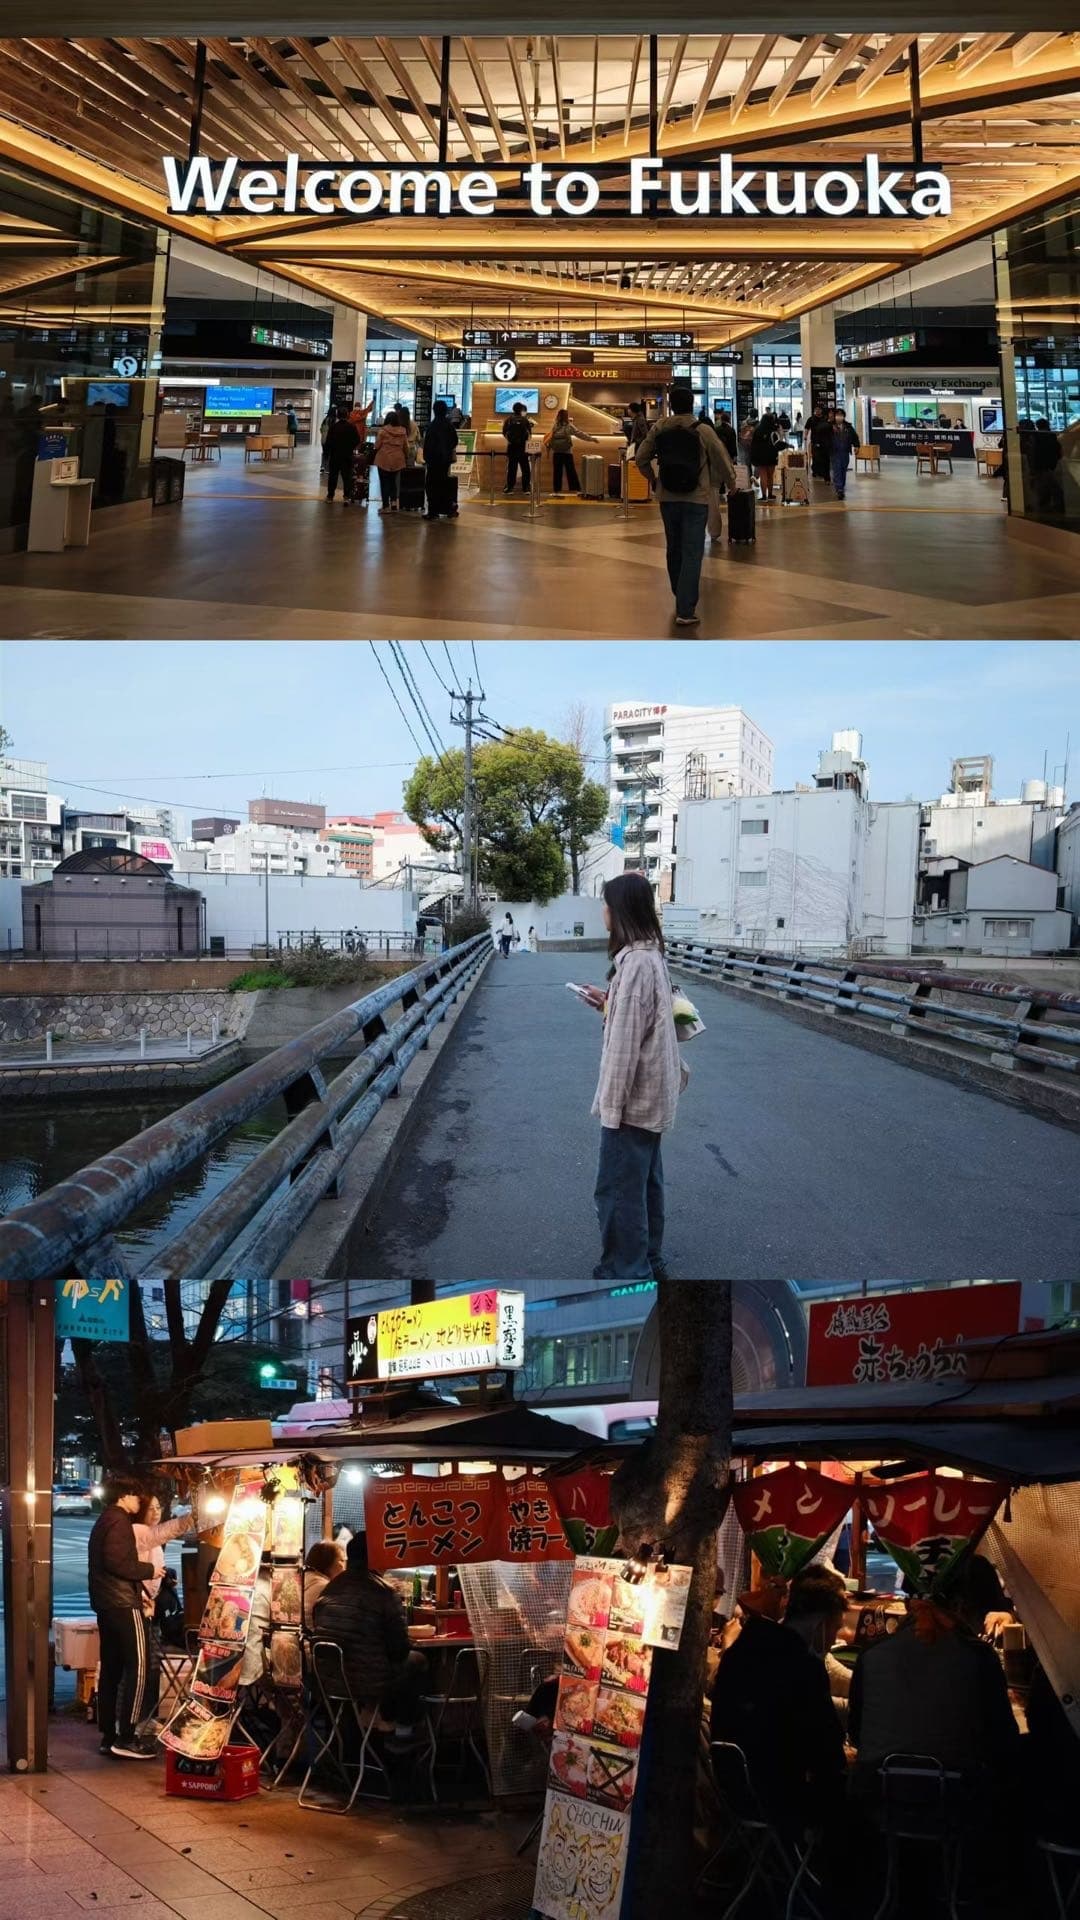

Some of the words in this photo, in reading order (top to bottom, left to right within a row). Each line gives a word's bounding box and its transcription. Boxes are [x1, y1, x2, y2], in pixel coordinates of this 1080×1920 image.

[163, 153, 498, 216] Welcome
[523, 162, 600, 216] to
[630, 153, 952, 216] Fukuoka
[582, 369, 619, 379] COFFEE
[892, 379, 937, 391] Currency
[941, 379, 993, 390] Exchange
[383, 1500, 482, 1531] とんこつ
[508, 1498, 560, 1525] やき
[383, 1529, 484, 1560] ラーメン
[508, 1525, 570, 1553] 焼ラー
[188, 1781, 218, 1792] SAPPORO
[567, 1803, 626, 1832] CHOCHIN
